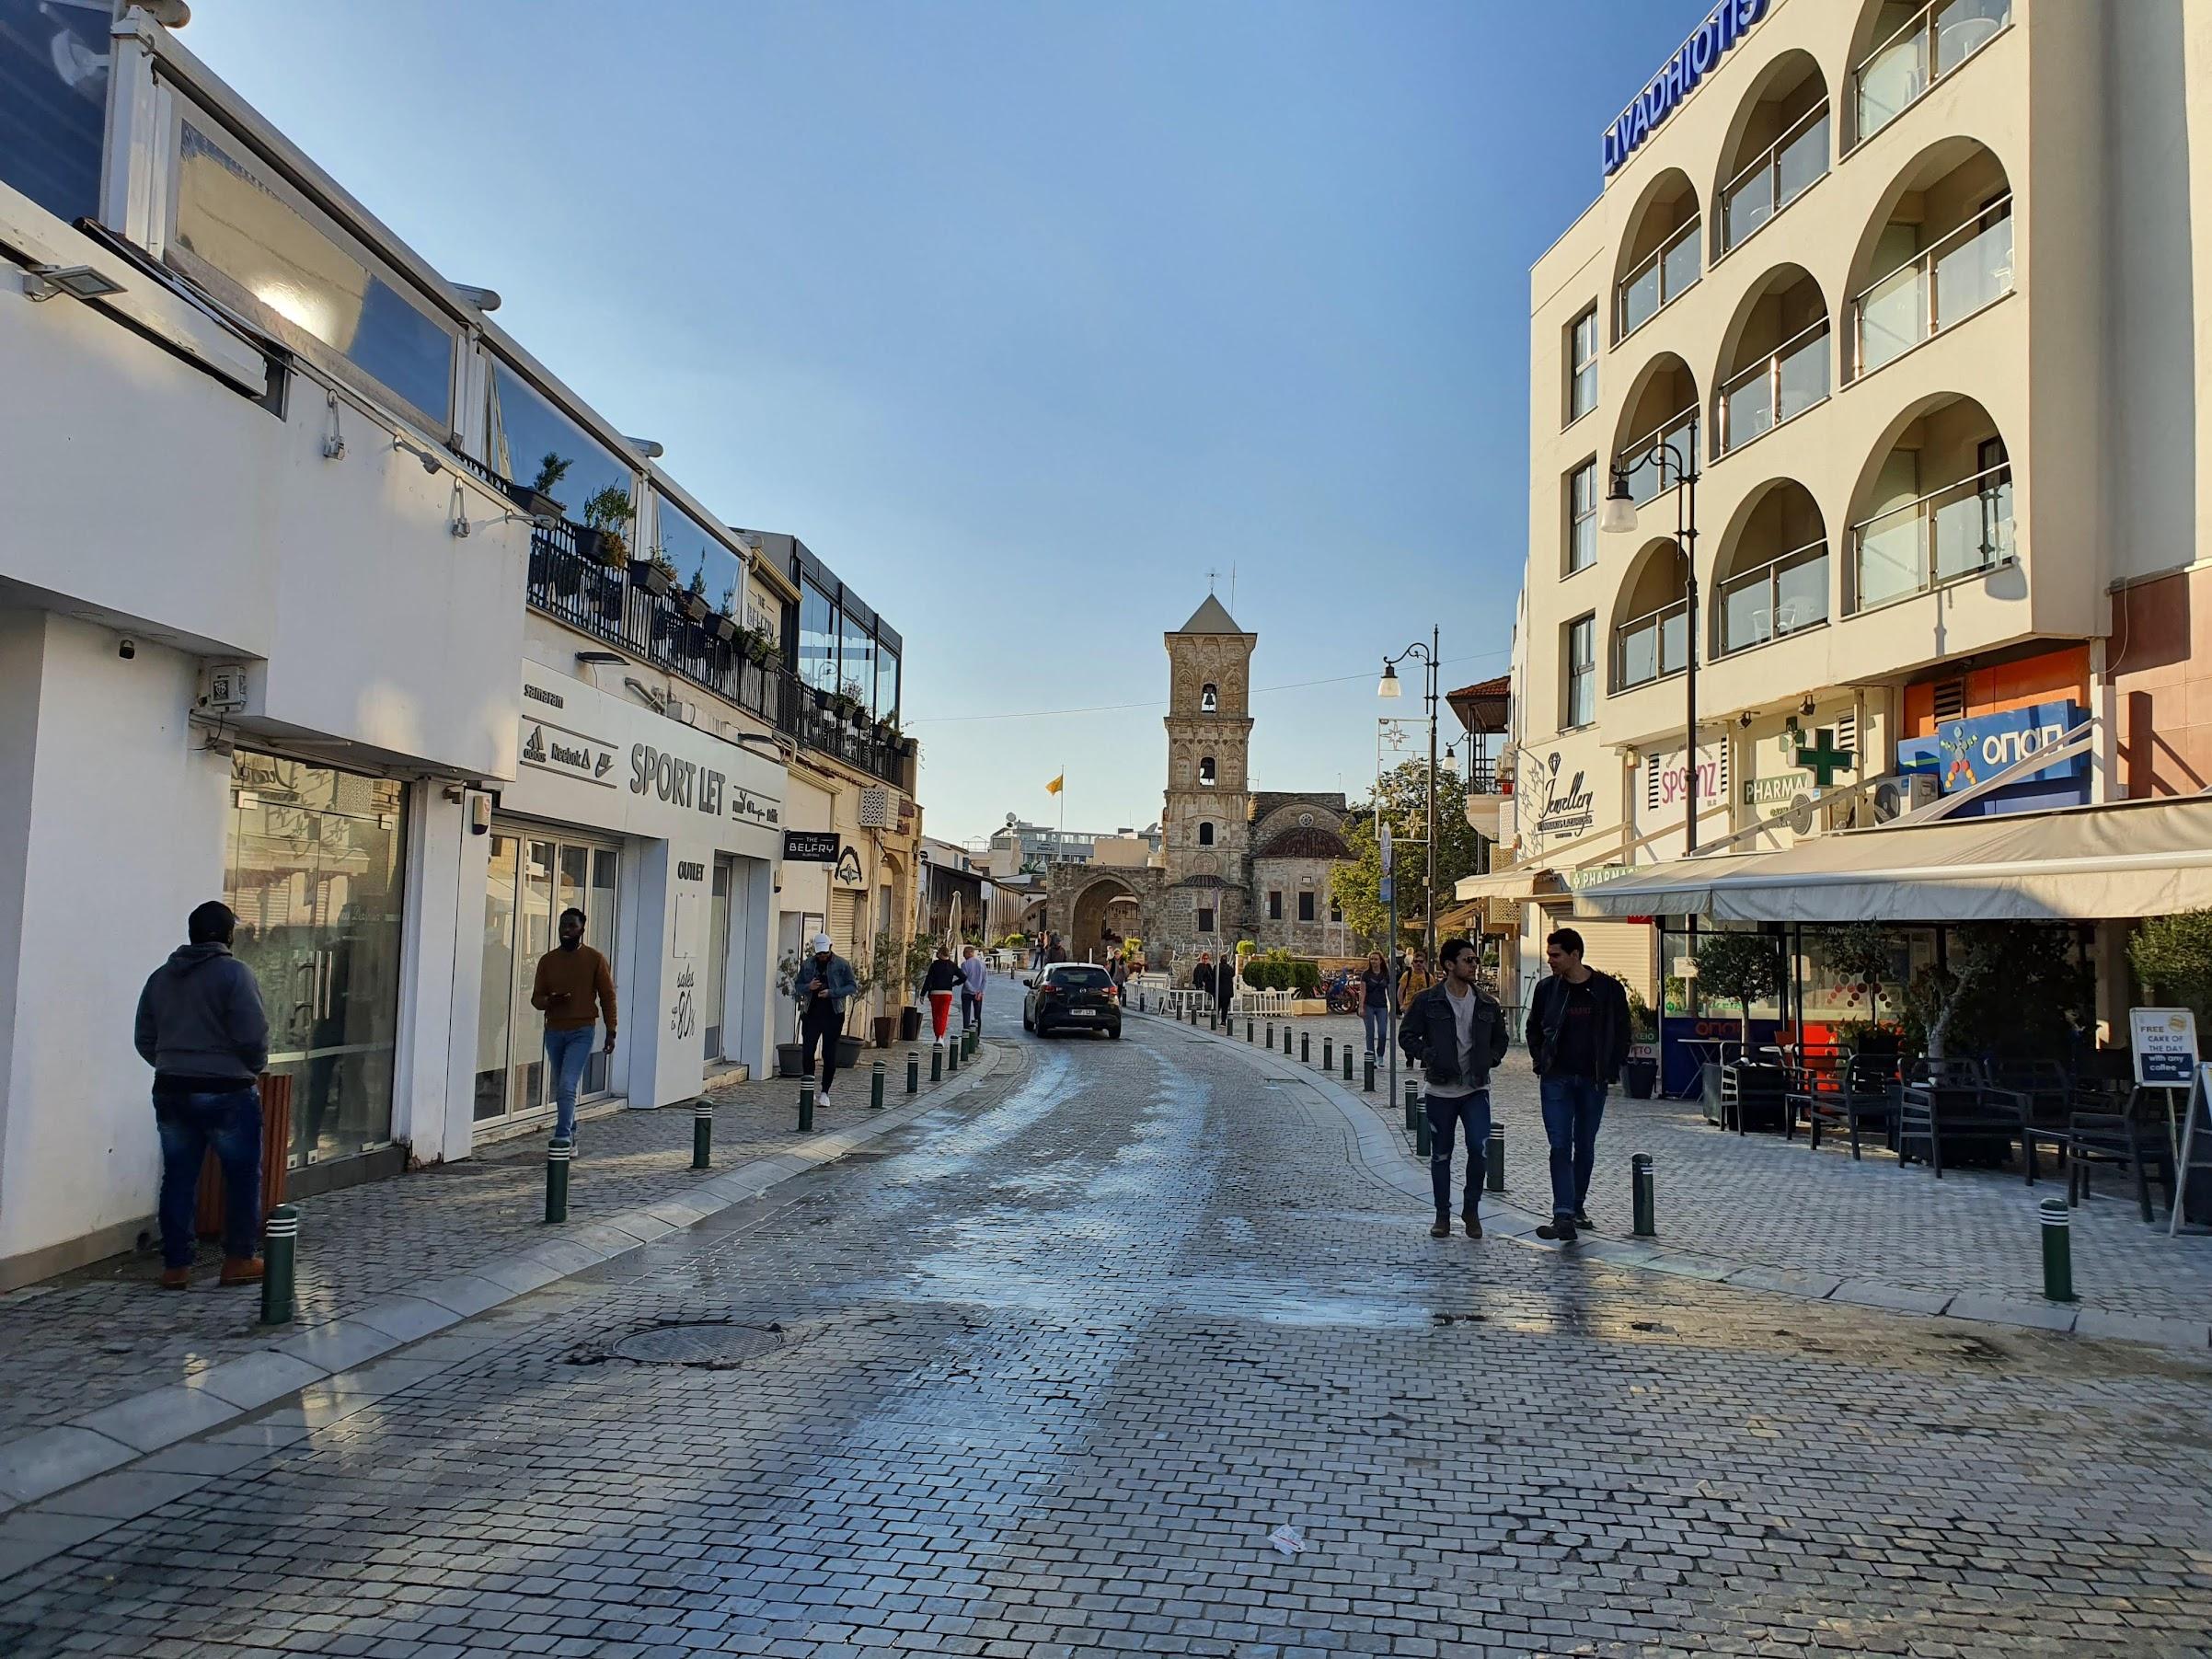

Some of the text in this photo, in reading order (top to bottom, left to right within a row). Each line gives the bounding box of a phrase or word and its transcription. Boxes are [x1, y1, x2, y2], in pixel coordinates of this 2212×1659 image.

[551, 743, 582, 766] Reebok
[630, 743, 697, 808] SPORT
[698, 766, 726, 816] LET
[1745, 775, 1809, 803] PHARMA
[1538, 770, 1594, 837] Jewellery
[789, 843, 835, 854] BELFRY
[677, 860, 705, 882] OUTLET
[677, 962, 695, 988] sales
[2149, 1063, 2177, 1071] coffee
[2167, 1055, 2184, 1064] any
